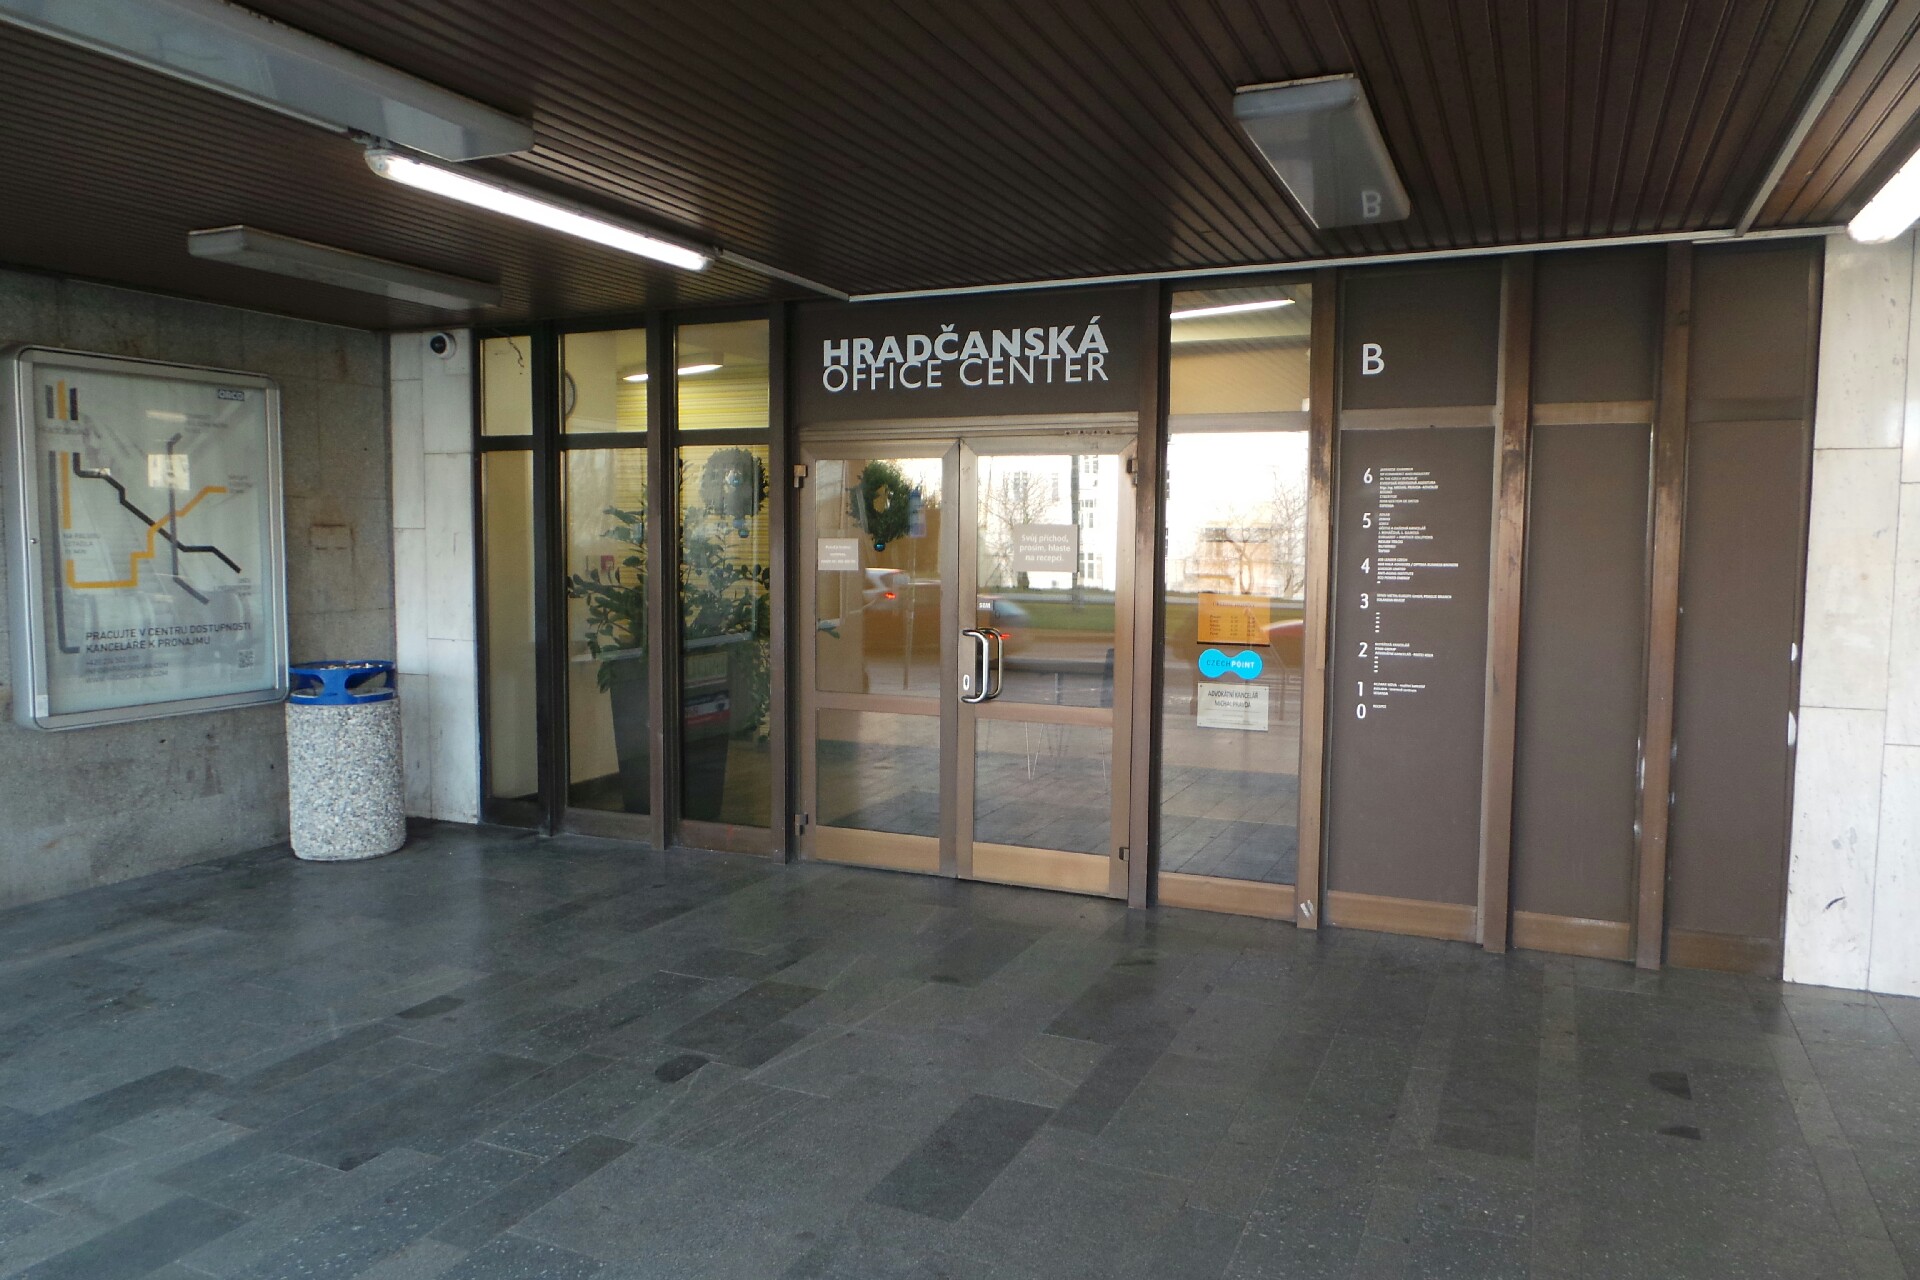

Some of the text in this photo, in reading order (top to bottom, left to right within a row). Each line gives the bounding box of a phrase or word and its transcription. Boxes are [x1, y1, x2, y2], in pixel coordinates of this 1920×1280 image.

[823, 315, 1109, 367] HRADČANSKÁ
[1362, 343, 1385, 375] B
[822, 352, 1109, 392] OFFICE CENTER
[1363, 467, 1373, 484] 6
[1362, 512, 1372, 529] 5
[1048, 543, 1071, 552] hlaste
[1360, 557, 1371, 574] 4
[1360, 593, 1369, 609] 3
[86, 628, 136, 641] PRACUJTE
[1358, 642, 1368, 657] 2
[1357, 681, 1363, 696] 1
[1356, 703, 1367, 719] 0
